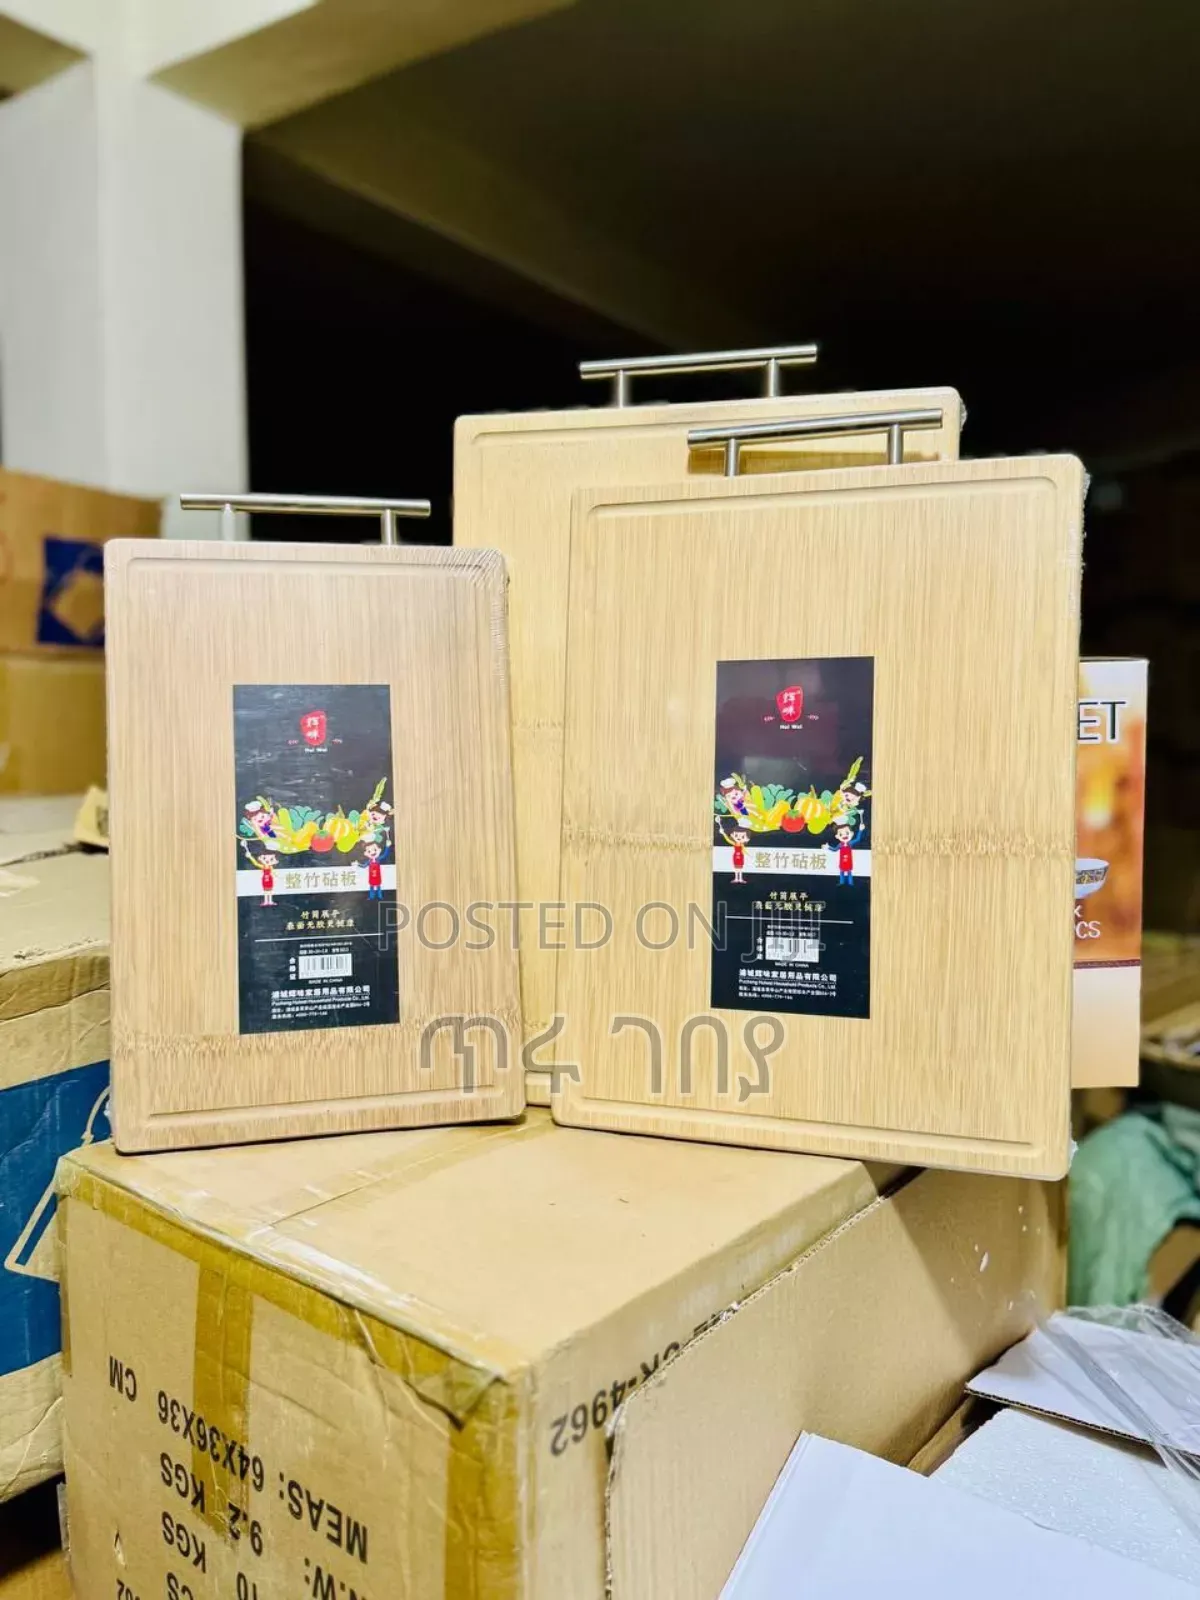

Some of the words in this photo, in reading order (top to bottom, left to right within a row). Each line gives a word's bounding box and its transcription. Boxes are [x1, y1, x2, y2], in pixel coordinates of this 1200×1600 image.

[285, 871, 357, 889] 整竹砧板
[755, 852, 827, 869] 整竹砧板
[1074, 921, 1101, 938] CS
[109, 1355, 136, 1402] CM
[158, 1390, 264, 1491] 64X36X36
[161, 1452, 205, 1513] KGS
[162, 1511, 206, 1573] KGS
[228, 1502, 263, 1556] 9.2
[279, 1472, 368, 1564] MEAS:
